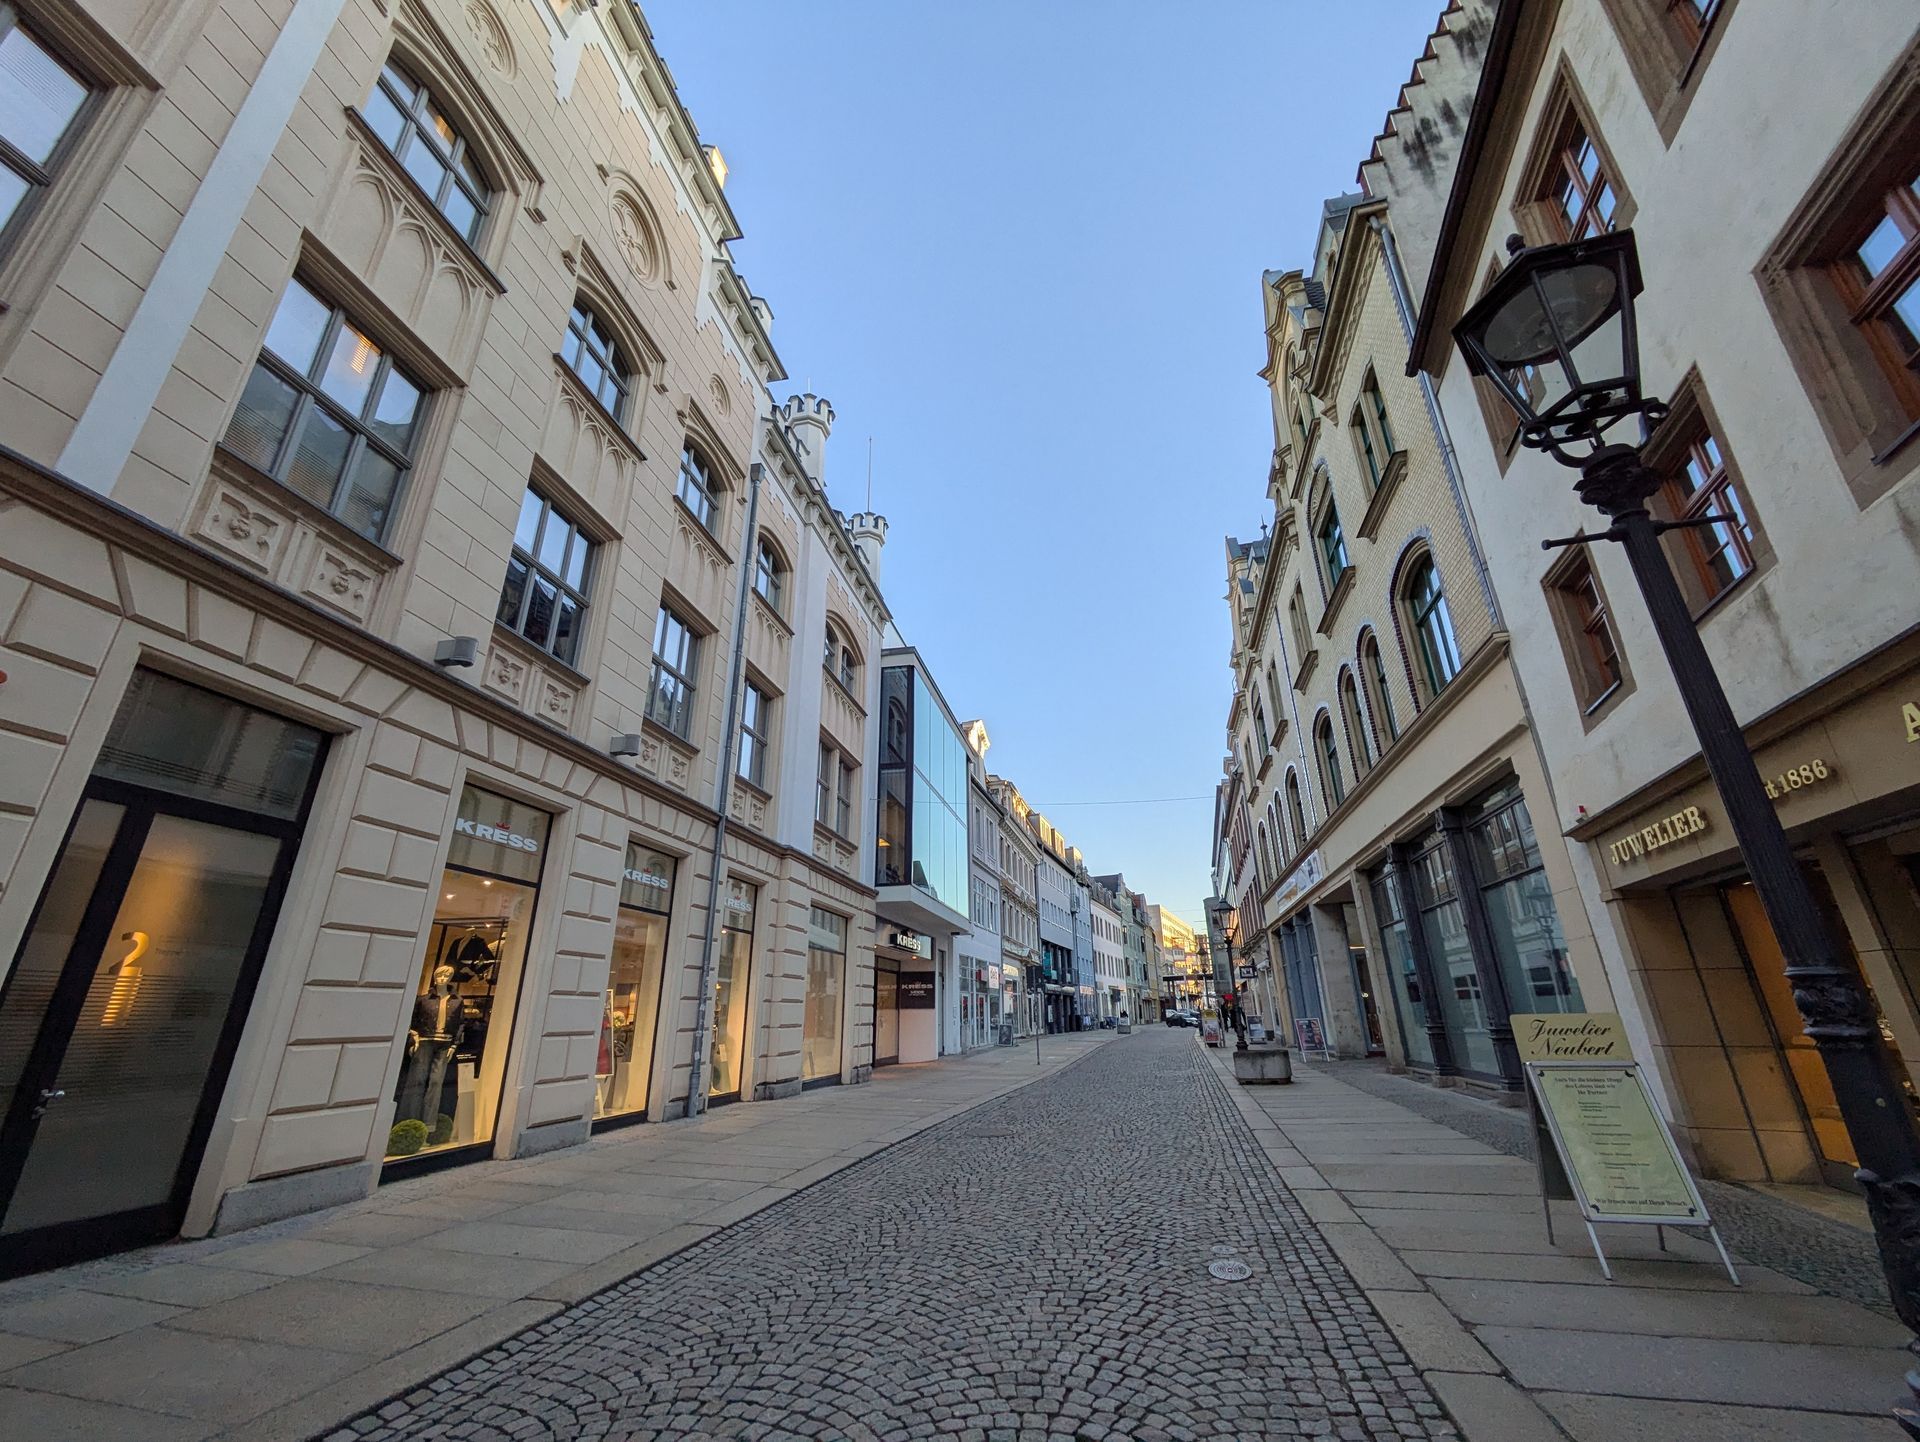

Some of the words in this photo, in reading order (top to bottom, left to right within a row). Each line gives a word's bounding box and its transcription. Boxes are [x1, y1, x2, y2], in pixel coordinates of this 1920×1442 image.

[1609, 806, 1705, 865] JUWELIER
[1777, 759, 1828, 793] 1886
[455, 818, 538, 852] KRESS
[897, 933, 921, 951] KRESS
[1528, 1019, 1611, 1042] Juwelier
[1531, 1038, 1615, 1056] Neubert
